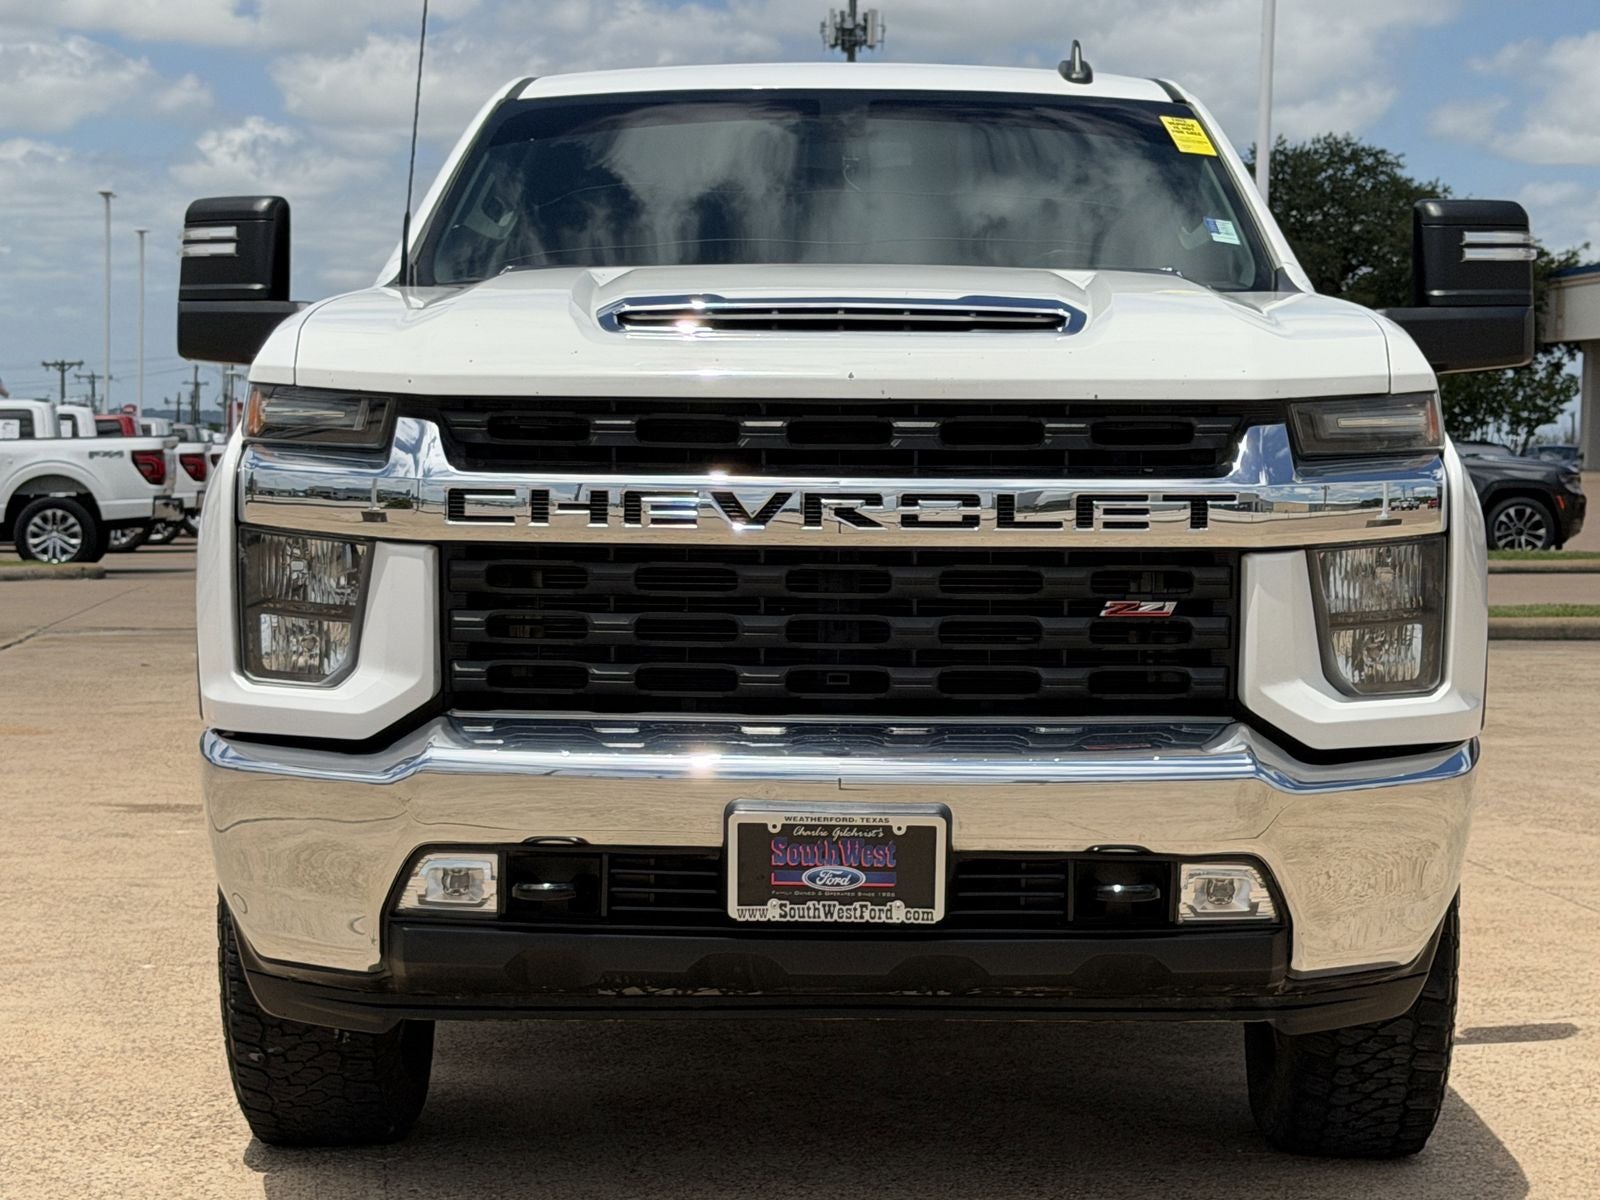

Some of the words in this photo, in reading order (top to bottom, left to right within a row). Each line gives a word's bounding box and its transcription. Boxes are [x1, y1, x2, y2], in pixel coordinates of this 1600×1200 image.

[446, 487, 1239, 531] CHEVROLET
[832, 827, 885, 841] Gilchrist's
[815, 869, 851, 886] Ford
